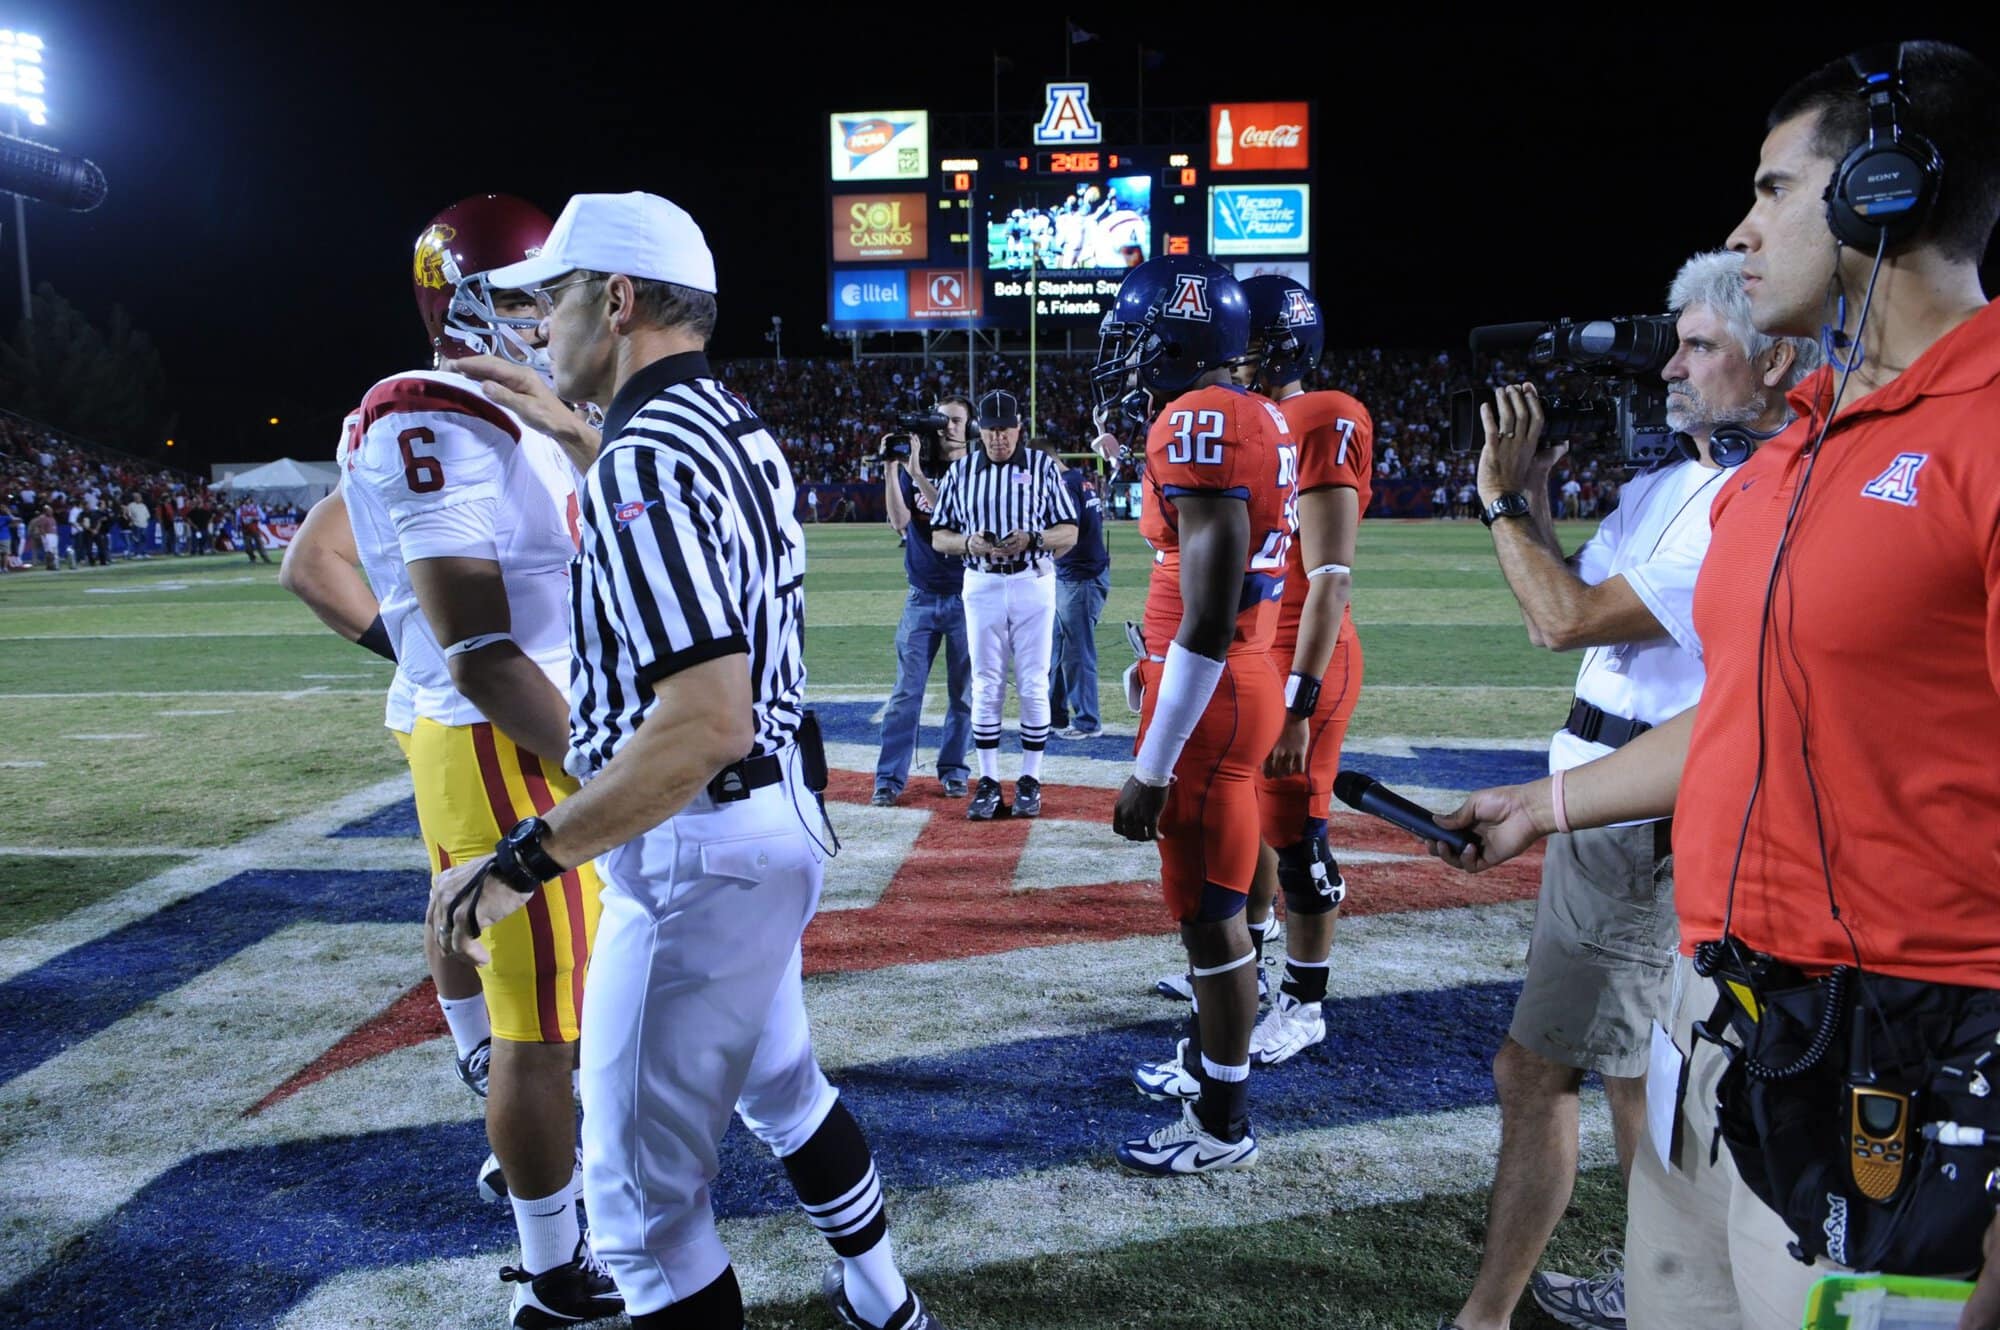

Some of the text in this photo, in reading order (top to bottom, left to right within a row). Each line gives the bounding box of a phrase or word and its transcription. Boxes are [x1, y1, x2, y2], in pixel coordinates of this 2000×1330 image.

[1034, 83, 1101, 144] A
[1051, 152, 1099, 172] 2:06
[955, 173, 969, 191] 0
[1181, 168, 1196, 186] 0
[1867, 171, 1900, 183] SONY
[1236, 195, 1283, 209] Tucson
[850, 201, 912, 233] SOL
[1241, 207, 1295, 221] Electric
[1246, 221, 1294, 234] Power
[850, 231, 912, 246] CASINOS
[995, 281, 1022, 296] Bob
[1038, 280, 1093, 298] Stephen
[1096, 280, 1122, 296] Sny
[1163, 274, 1212, 322] A
[1037, 300, 1100, 314] & Friends
[1284, 289, 1317, 327] A
[1167, 410, 1225, 465] 32
[1334, 417, 1356, 466] 7
[397, 426, 445, 493] 6
[1861, 453, 1929, 506] A
